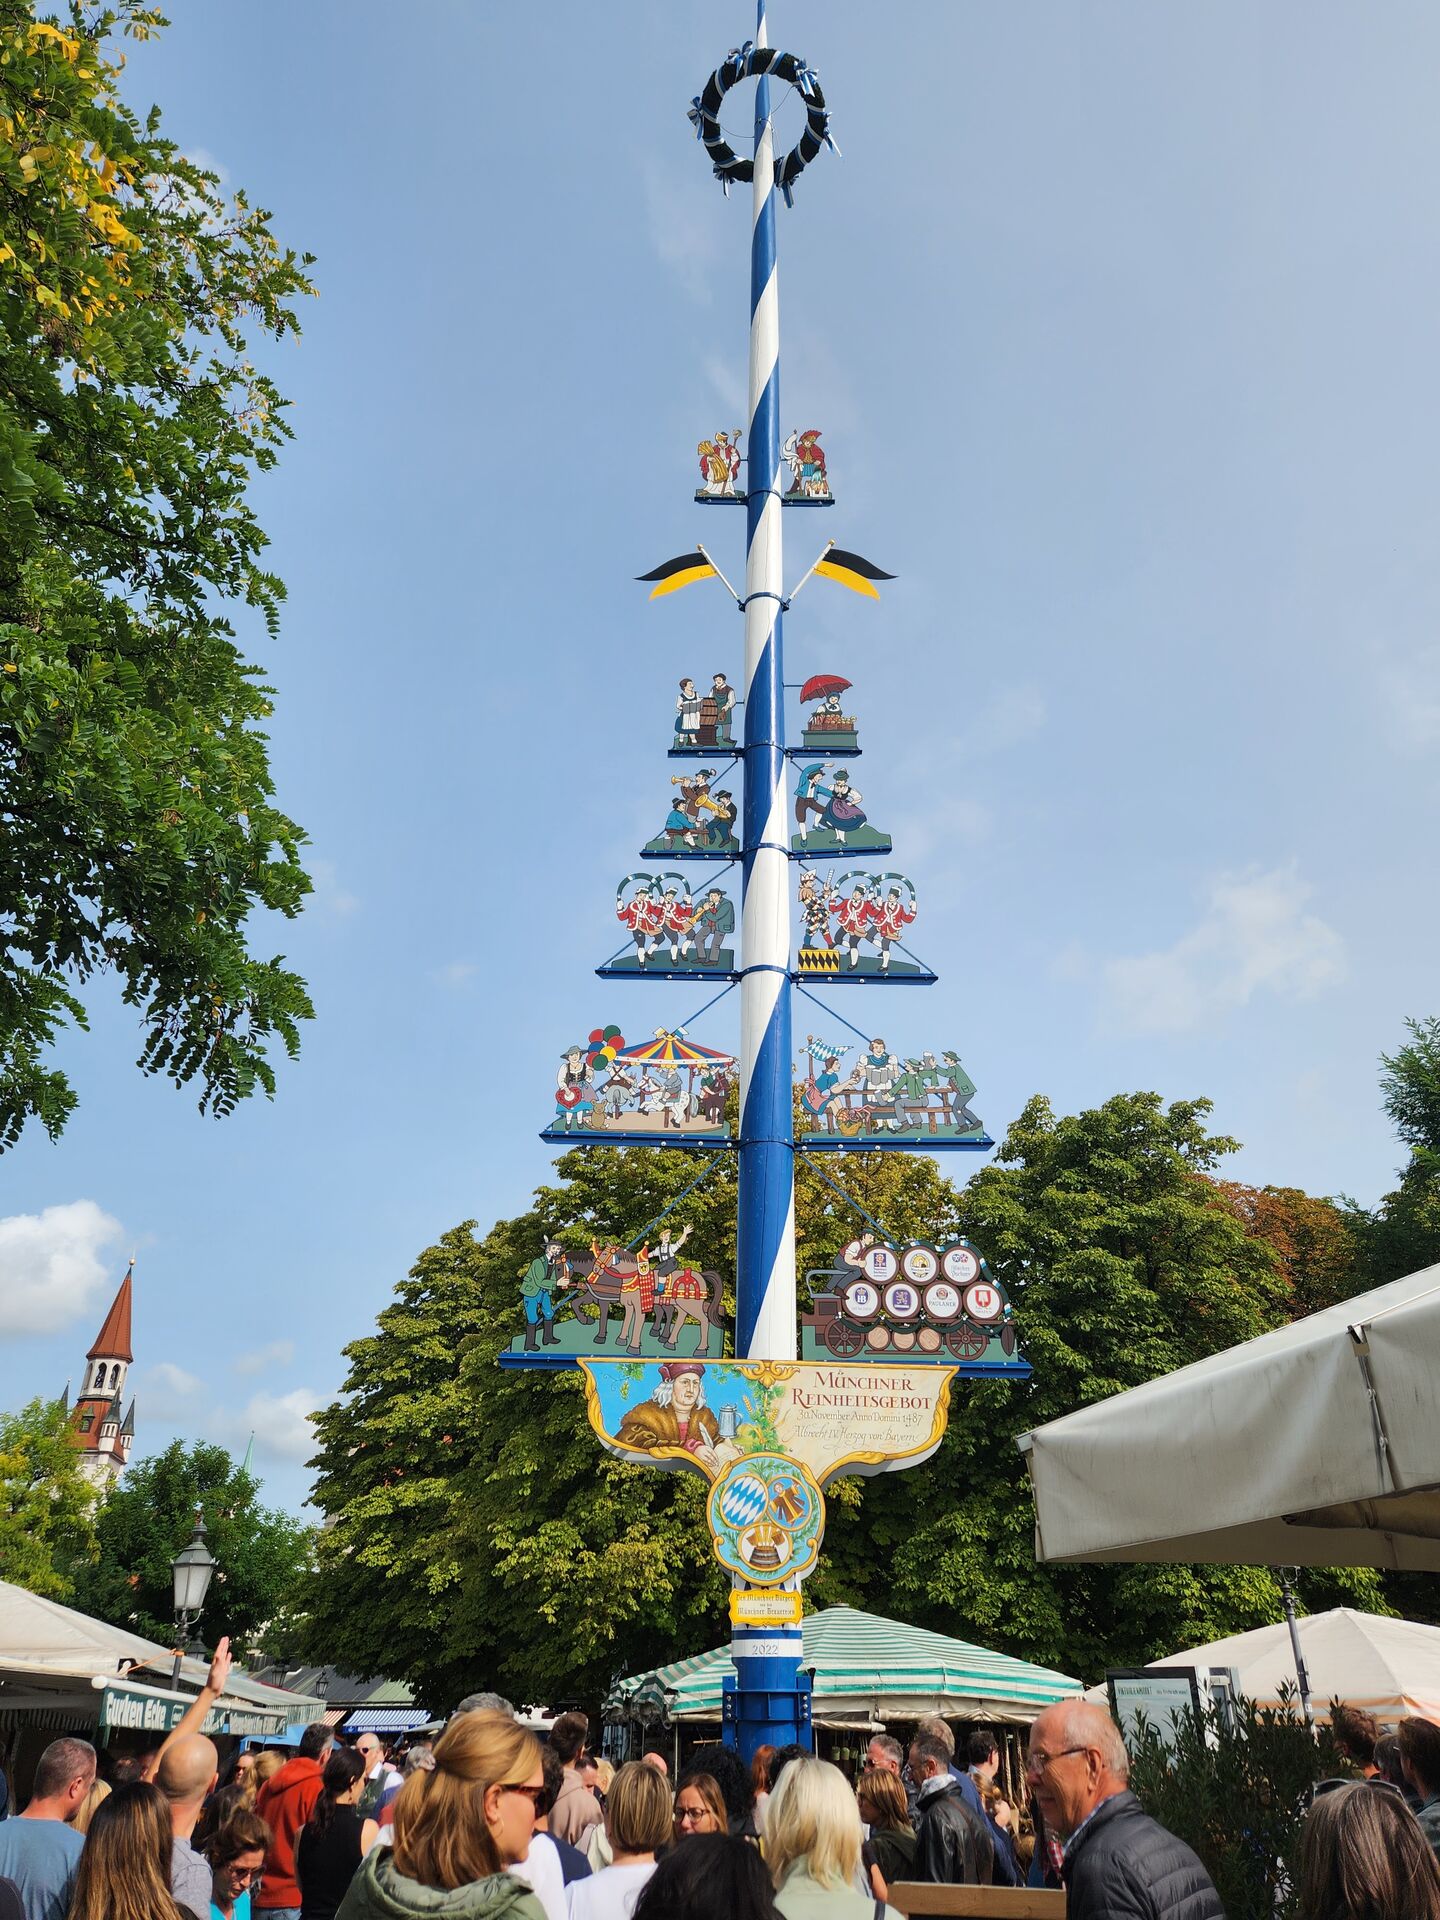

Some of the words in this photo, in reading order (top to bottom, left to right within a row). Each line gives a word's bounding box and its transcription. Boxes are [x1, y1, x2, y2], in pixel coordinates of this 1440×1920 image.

[814, 1370, 917, 1391] MÜNCHNER
[792, 1388, 932, 1409] REINHEITSGEBOT
[811, 1409, 850, 1421] November
[851, 1411, 873, 1422] Anno
[873, 1412, 901, 1423] Domini
[903, 1413, 923, 1427] 1487
[795, 1423, 827, 1438] Albrecht
[838, 1425, 867, 1444] Herzog
[752, 1644, 778, 1655] 2022
[106, 1691, 144, 1728] Gurken
[144, 1699, 167, 1730] Ecke
